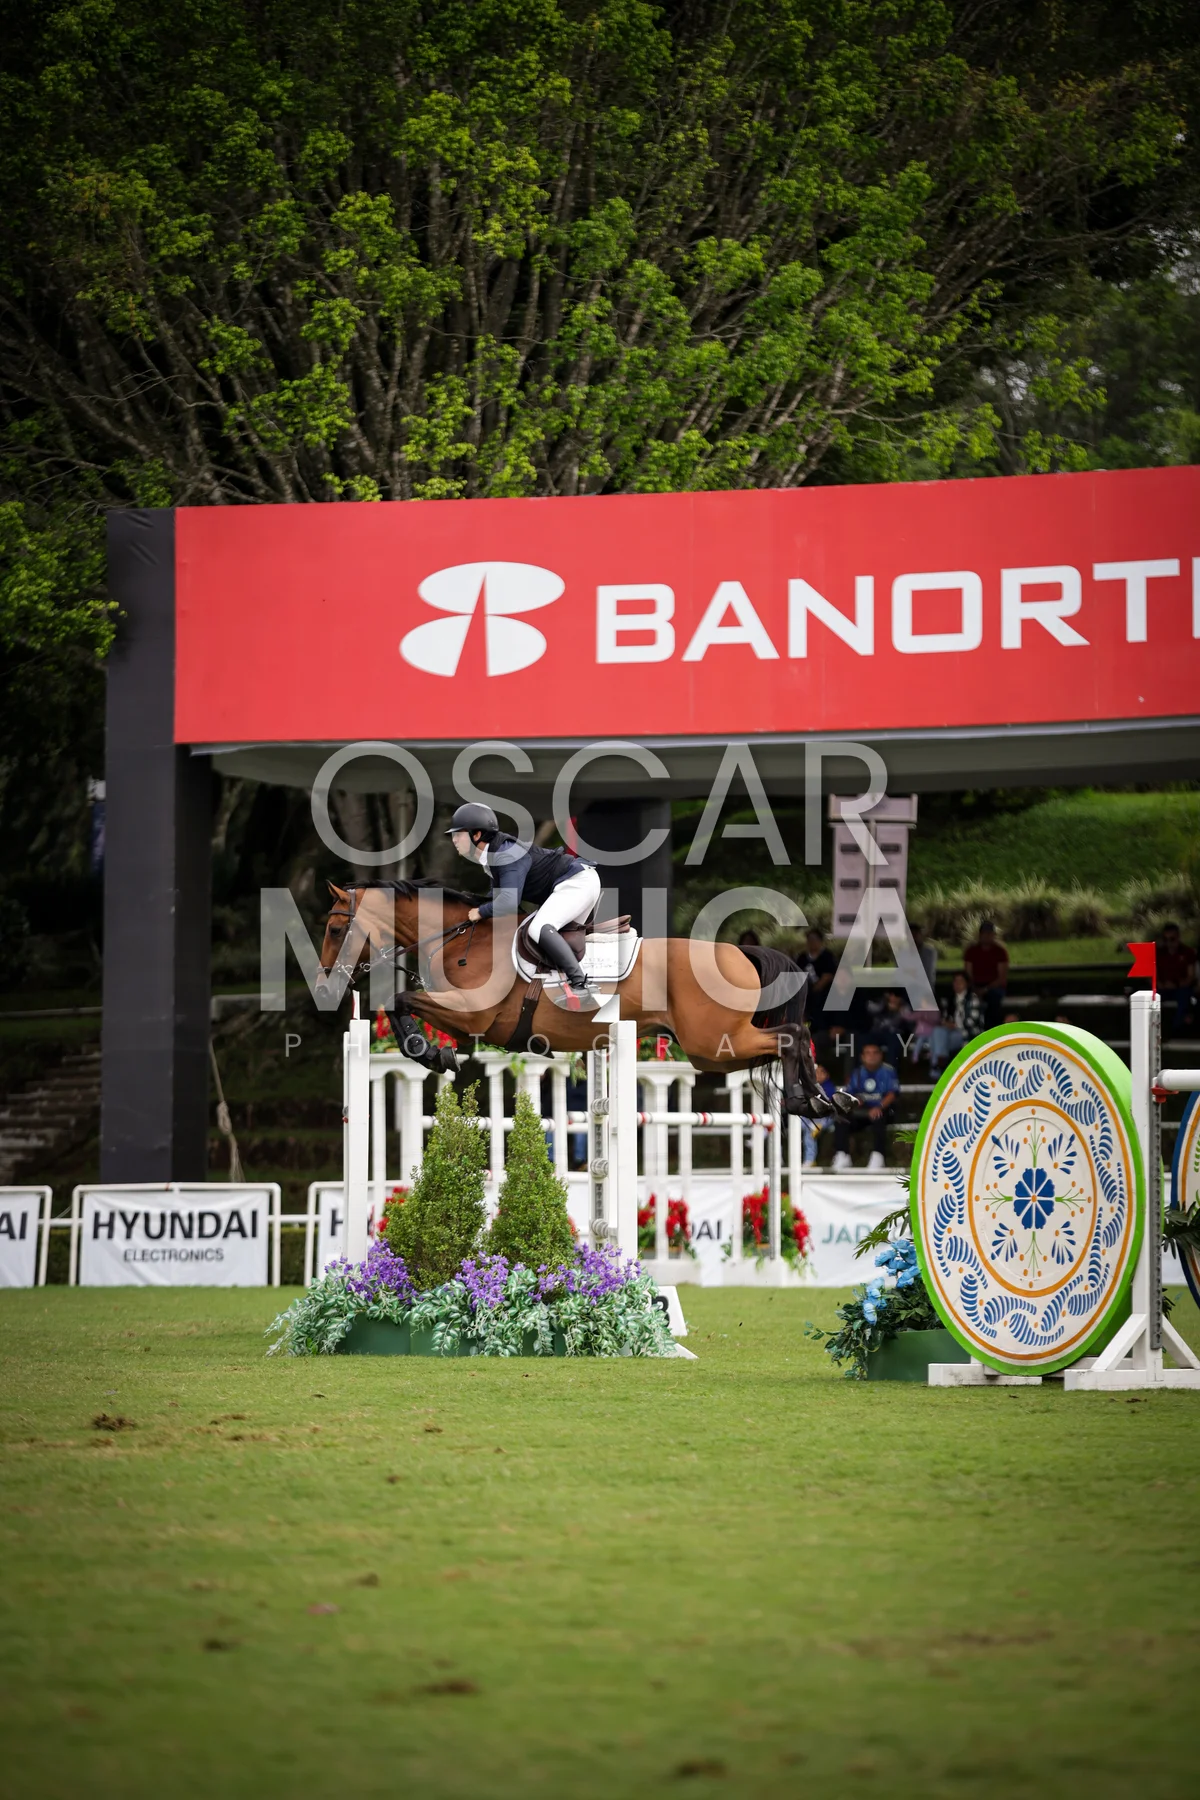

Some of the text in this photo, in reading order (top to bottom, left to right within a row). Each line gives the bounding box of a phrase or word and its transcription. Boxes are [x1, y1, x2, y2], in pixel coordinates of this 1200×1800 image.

[597, 557, 1200, 664] BANORT
[92, 1209, 258, 1239] HYUNDAI
[123, 1248, 225, 1263] ELECTRONICS
